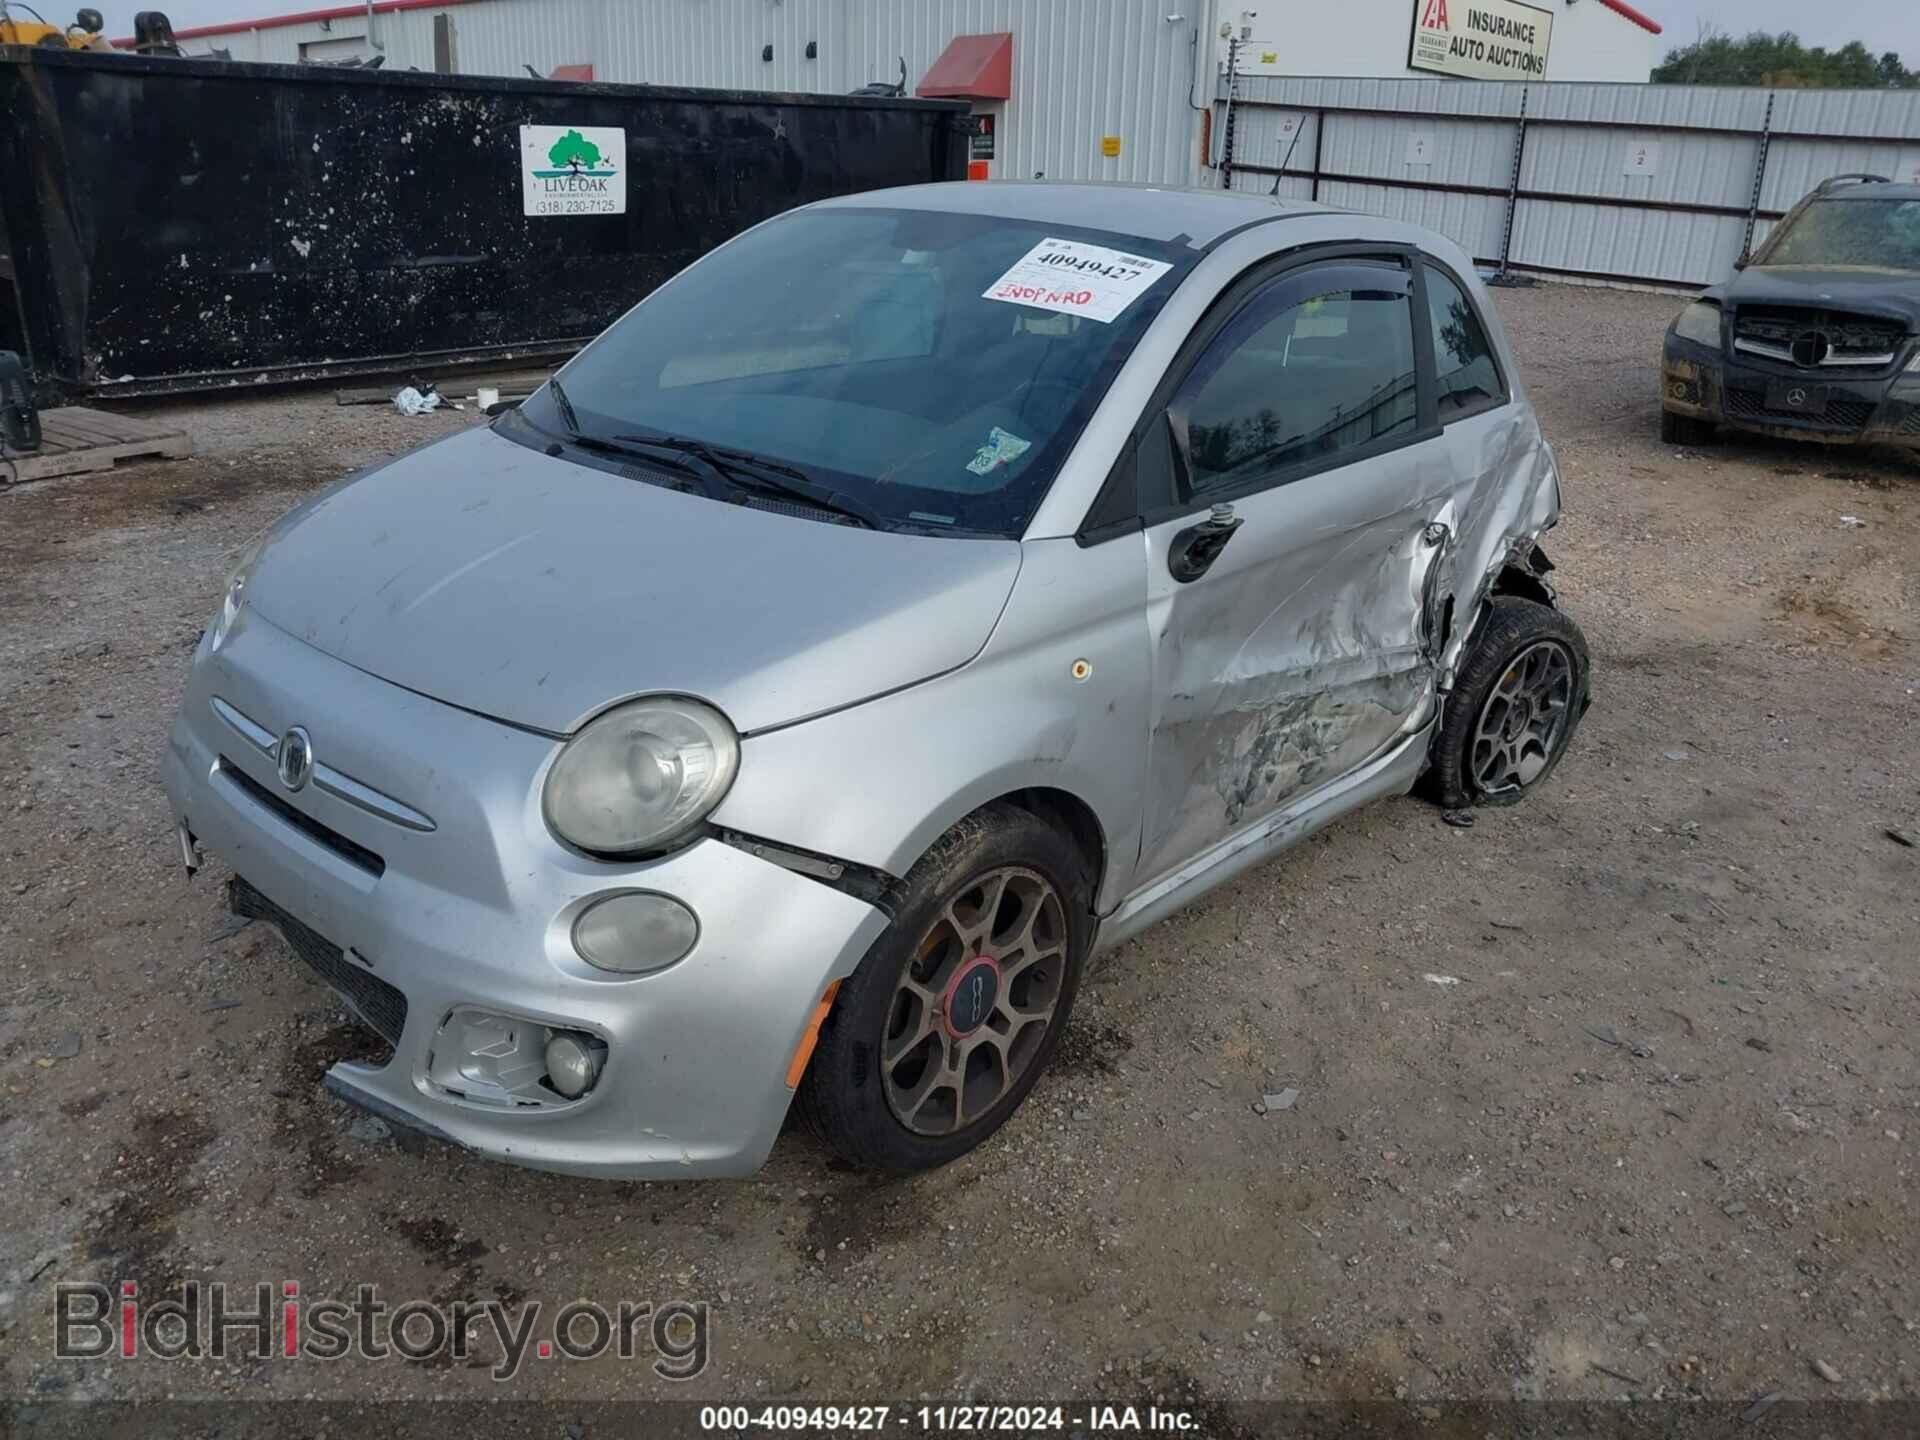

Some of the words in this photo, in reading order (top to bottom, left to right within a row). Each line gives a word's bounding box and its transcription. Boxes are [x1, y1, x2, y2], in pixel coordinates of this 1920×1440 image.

[1467, 8, 1536, 45] INSURANCE
[1449, 35, 1484, 61] AUTO
[1487, 43, 1544, 75] AUCTIONS
[566, 199, 615, 213] 230-7125
[1037, 252, 1141, 283] 40949427
